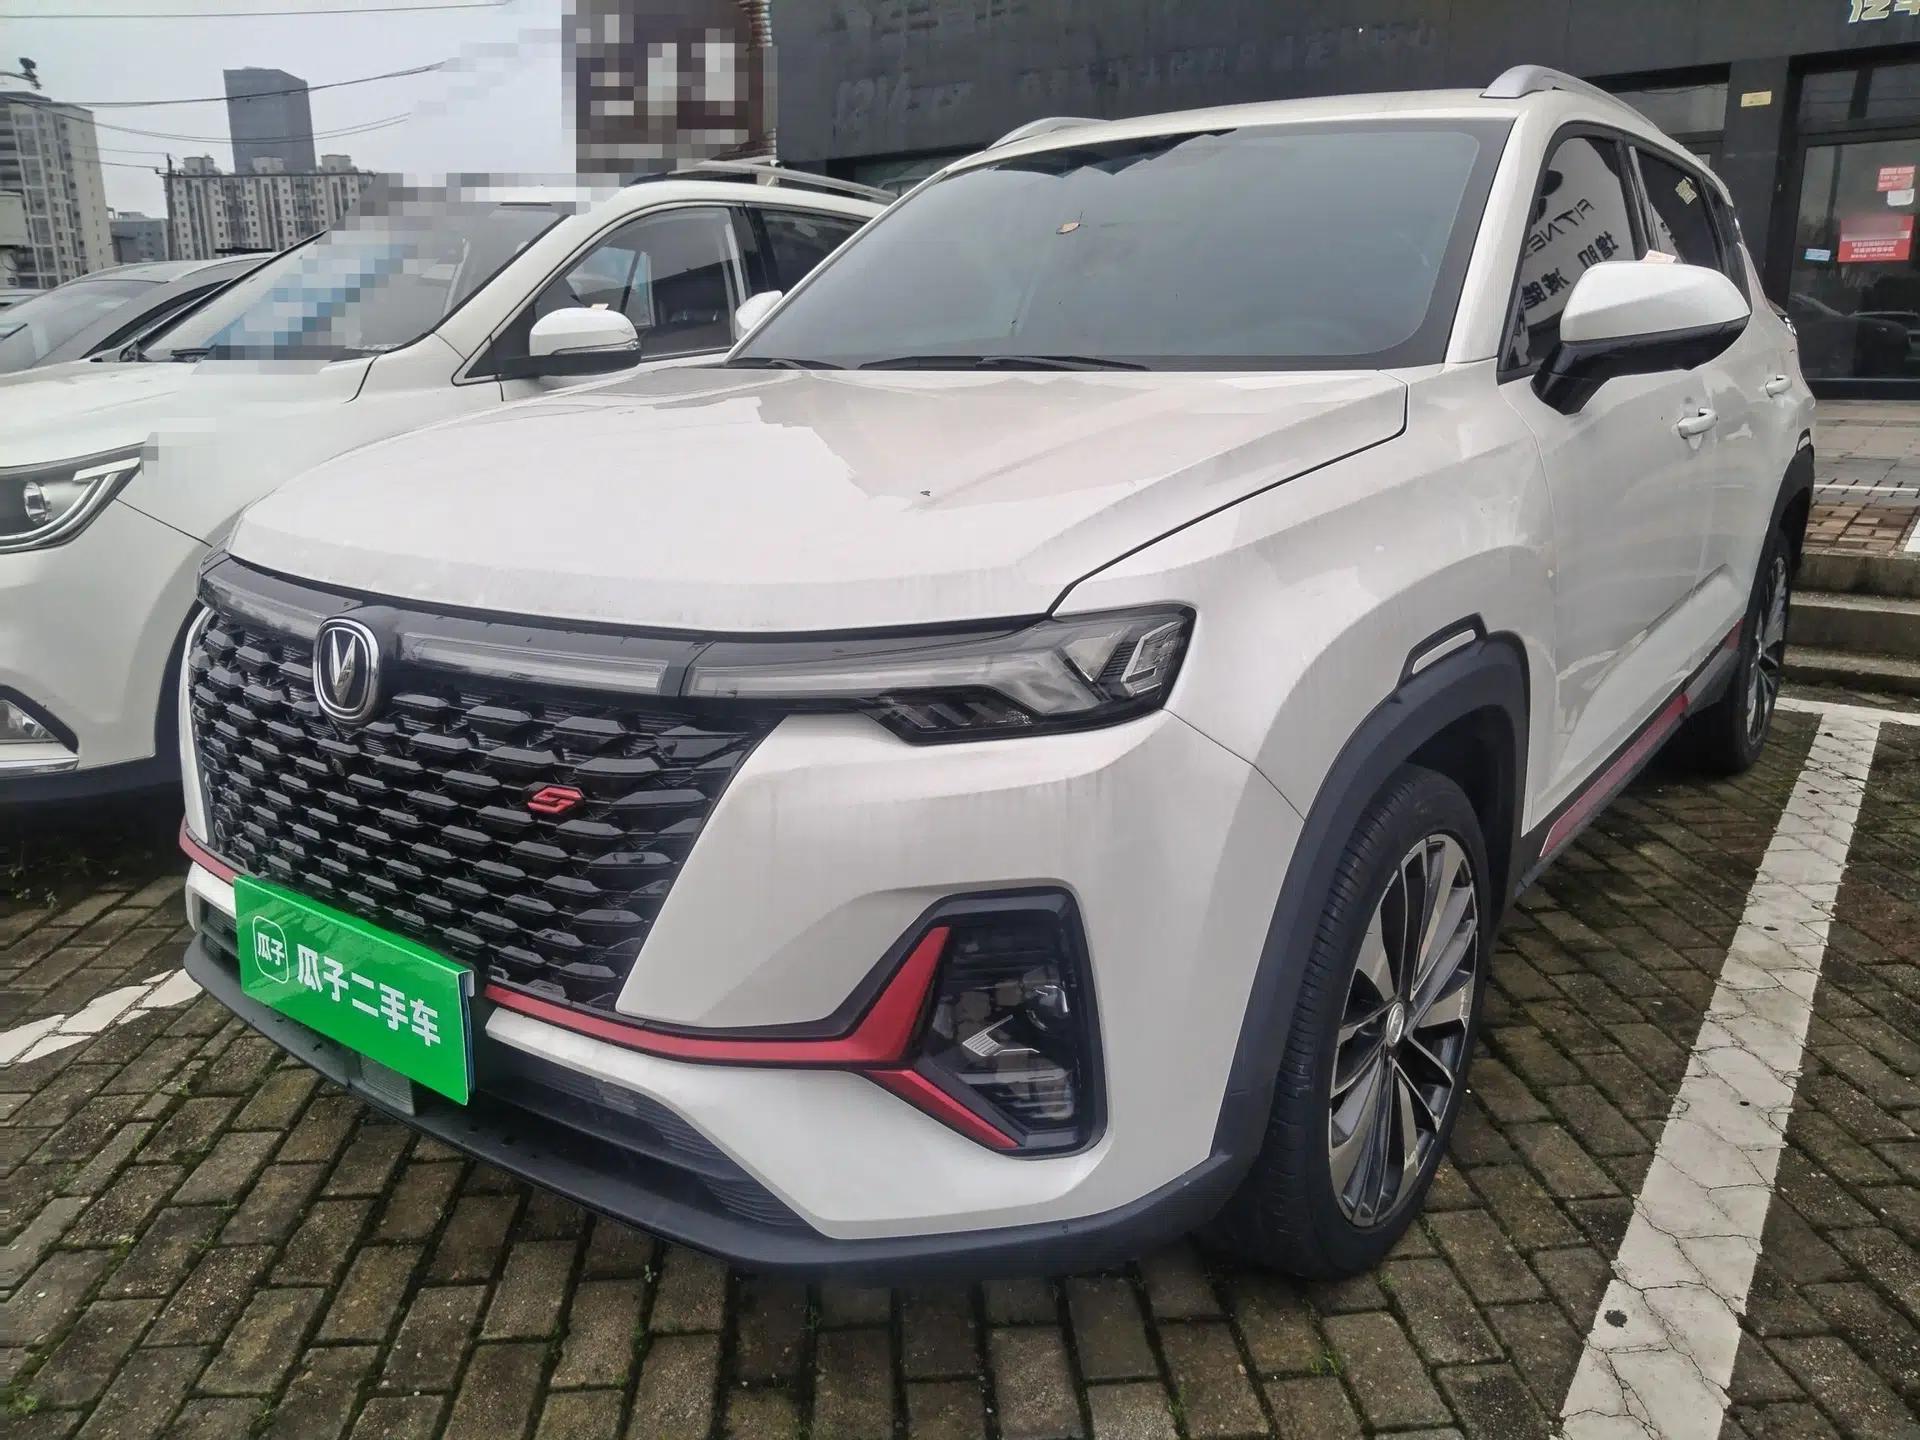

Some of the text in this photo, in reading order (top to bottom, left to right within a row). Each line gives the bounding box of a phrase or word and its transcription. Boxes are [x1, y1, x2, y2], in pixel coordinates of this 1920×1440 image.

[256, 931, 286, 966] 瓜子
[296, 943, 441, 1047] 瓜子二手车
